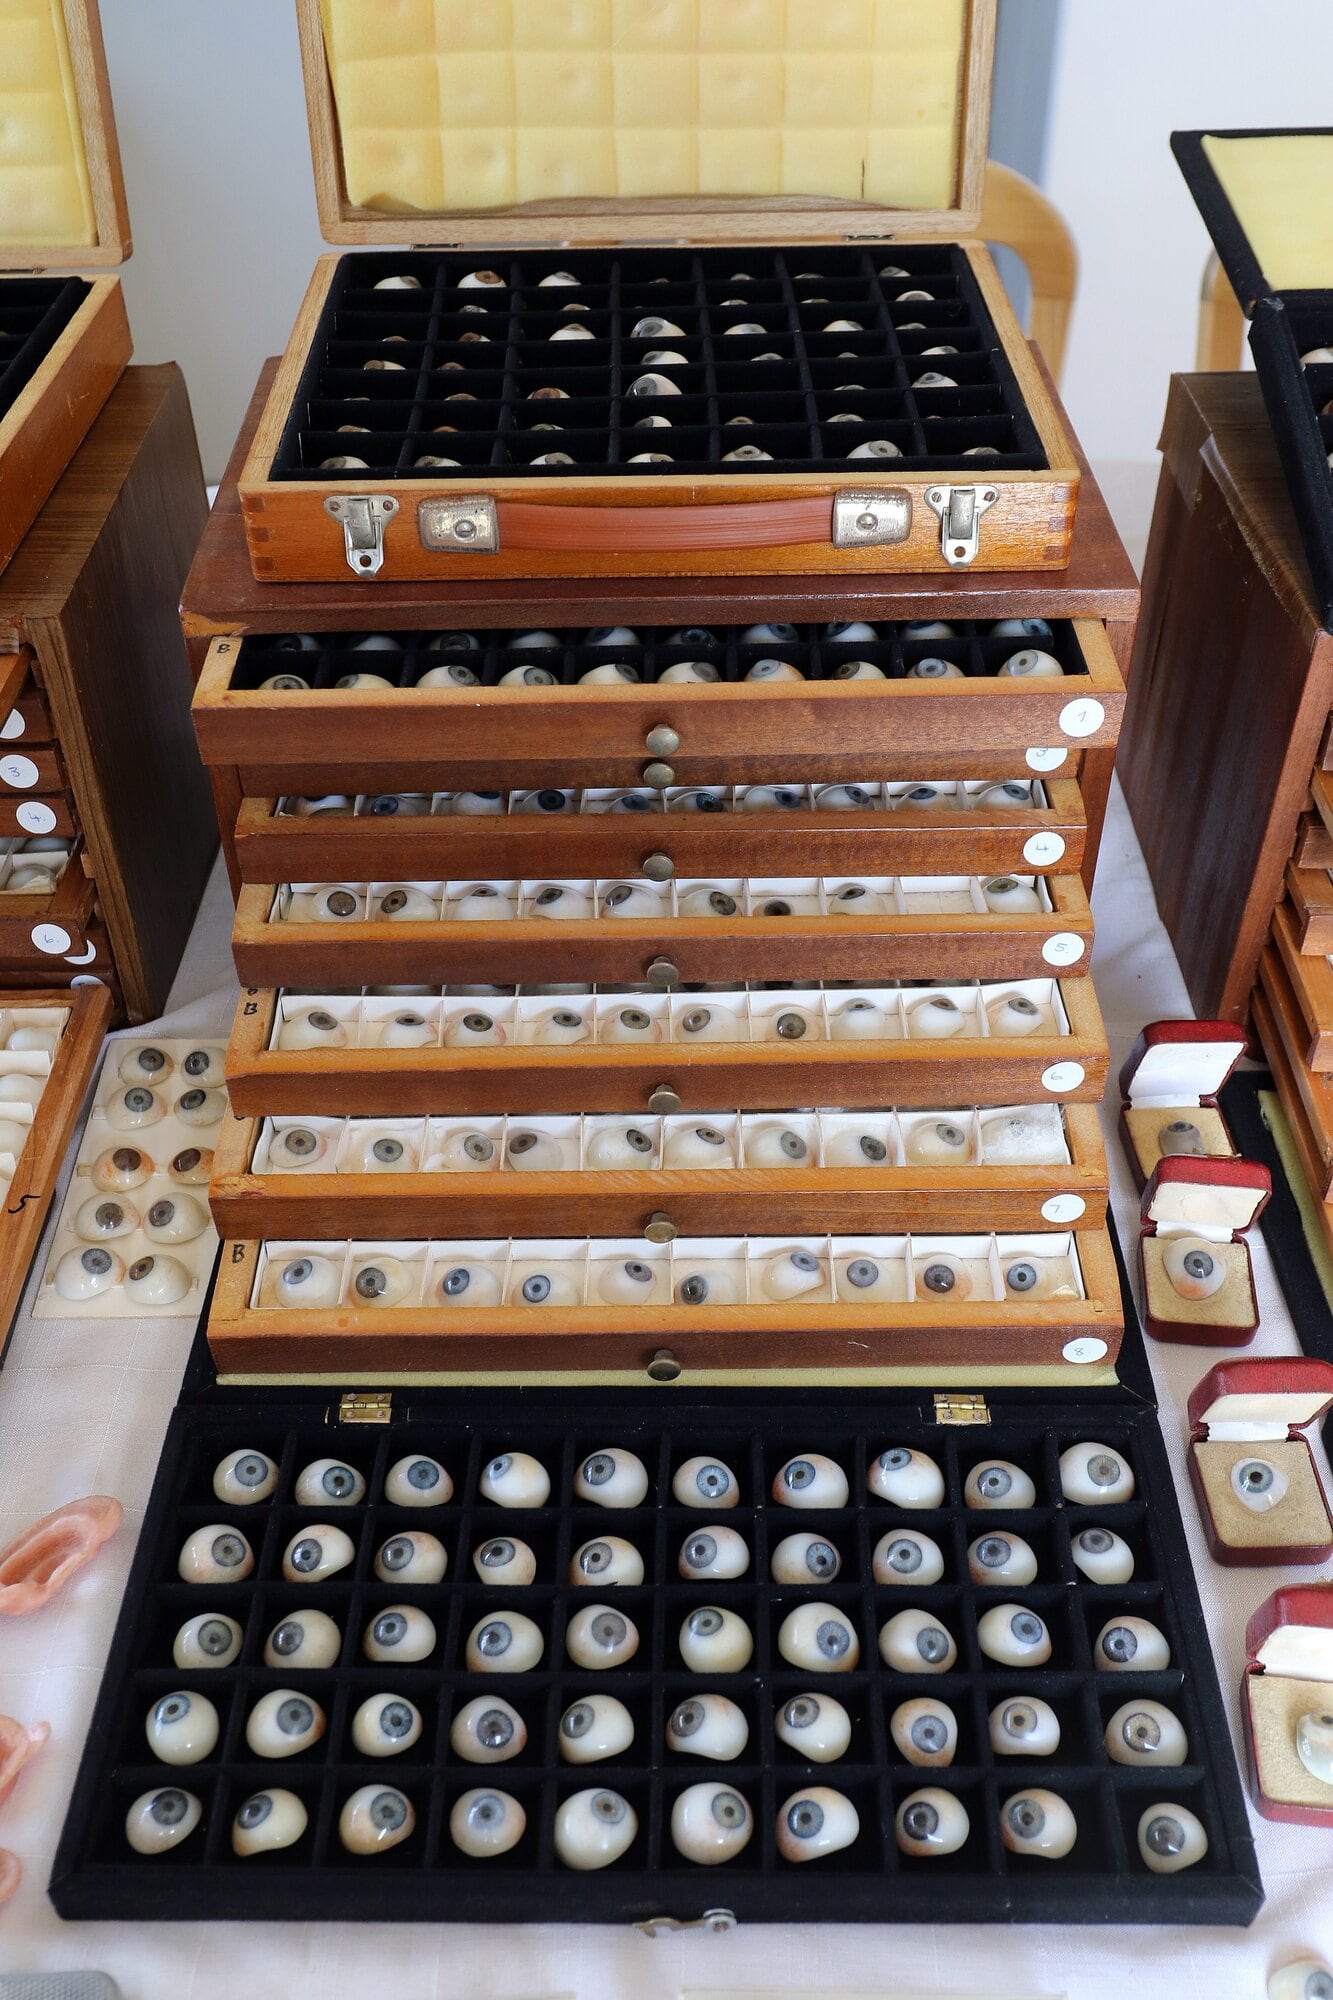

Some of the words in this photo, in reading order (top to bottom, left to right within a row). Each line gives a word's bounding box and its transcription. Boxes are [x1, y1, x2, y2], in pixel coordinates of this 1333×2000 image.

[8, 766, 21, 778] 3
[243, 1002, 258, 1016] B
[7, 1194, 41, 1214] 5
[232, 1243, 246, 1264] B
